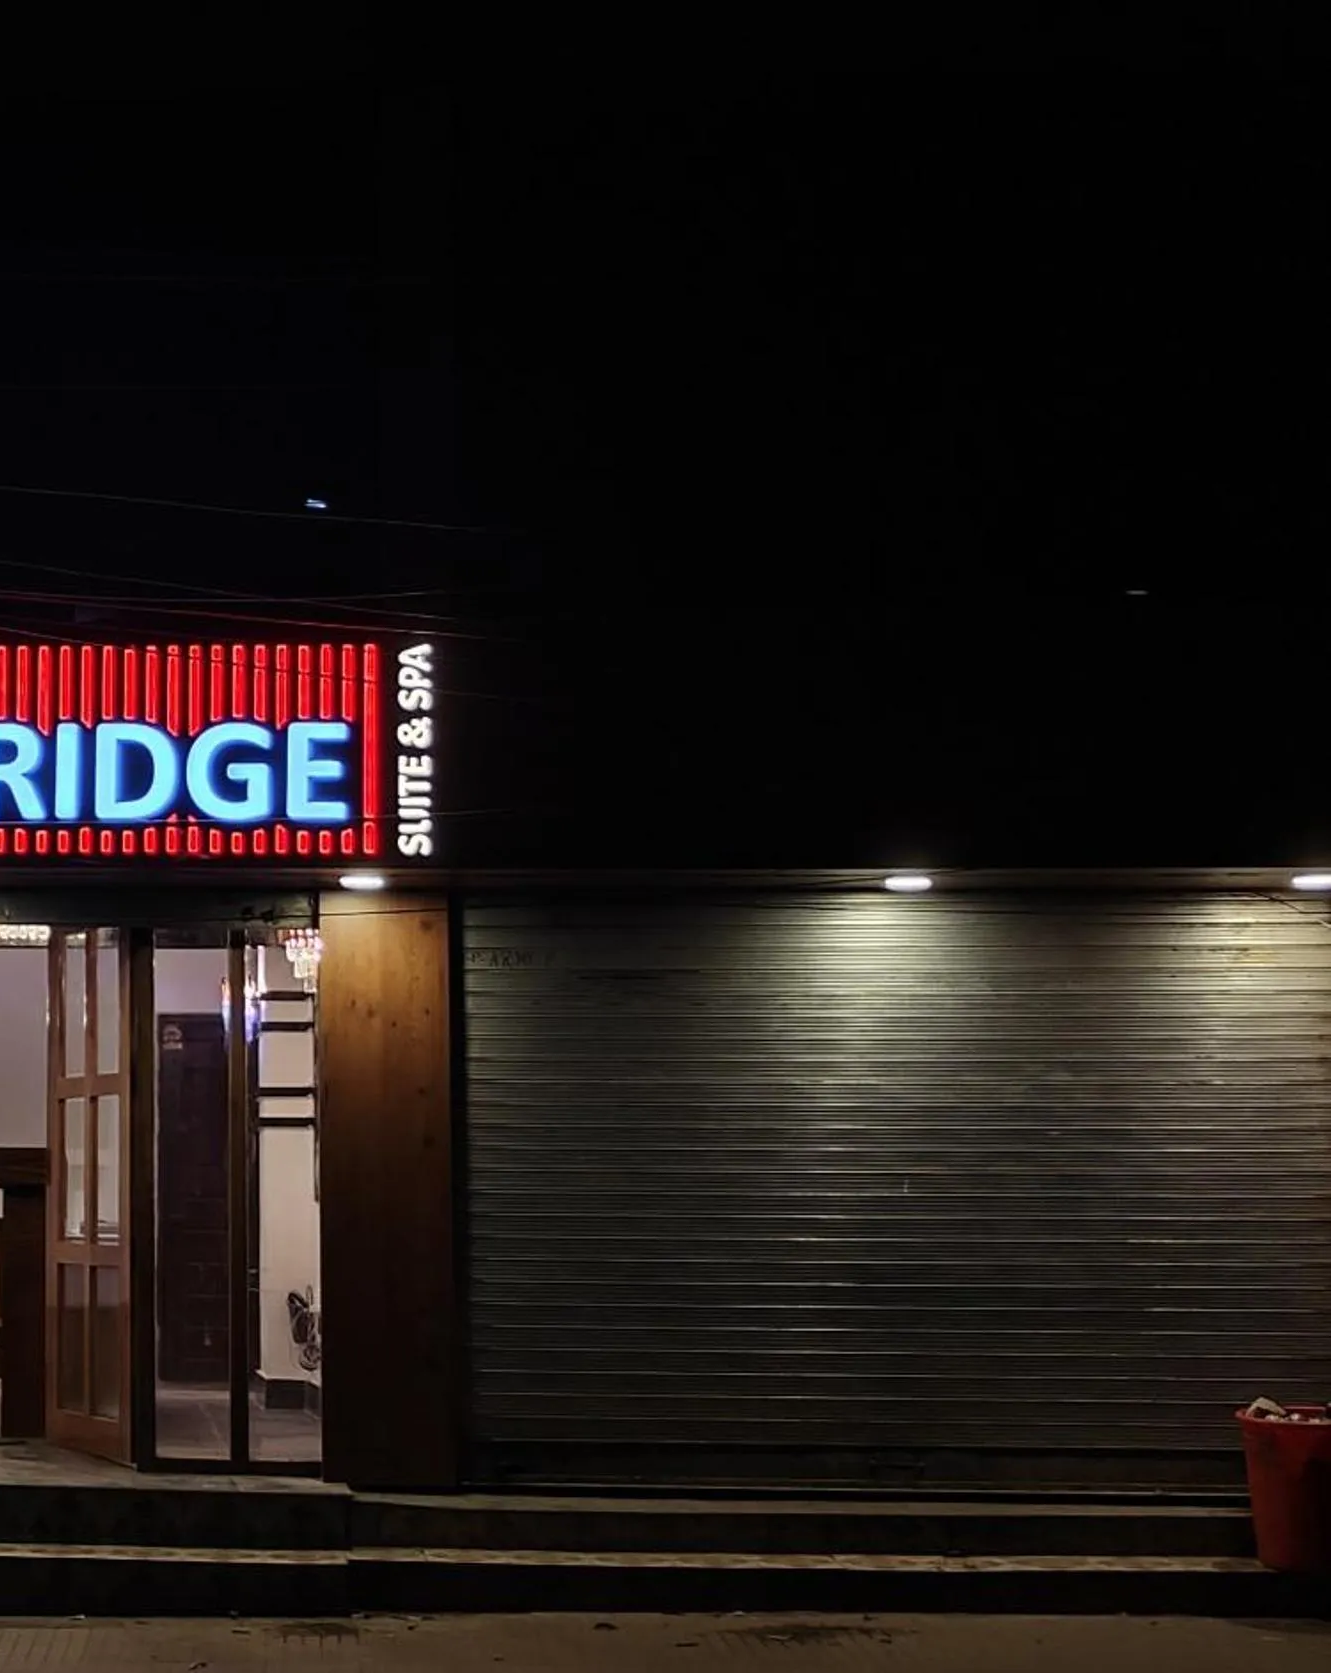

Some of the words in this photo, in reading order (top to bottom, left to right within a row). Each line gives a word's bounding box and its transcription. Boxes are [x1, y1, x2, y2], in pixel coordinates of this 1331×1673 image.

[397, 643, 433, 711] SPA
[396, 716, 433, 749] &
[397, 754, 433, 857] SUITE
